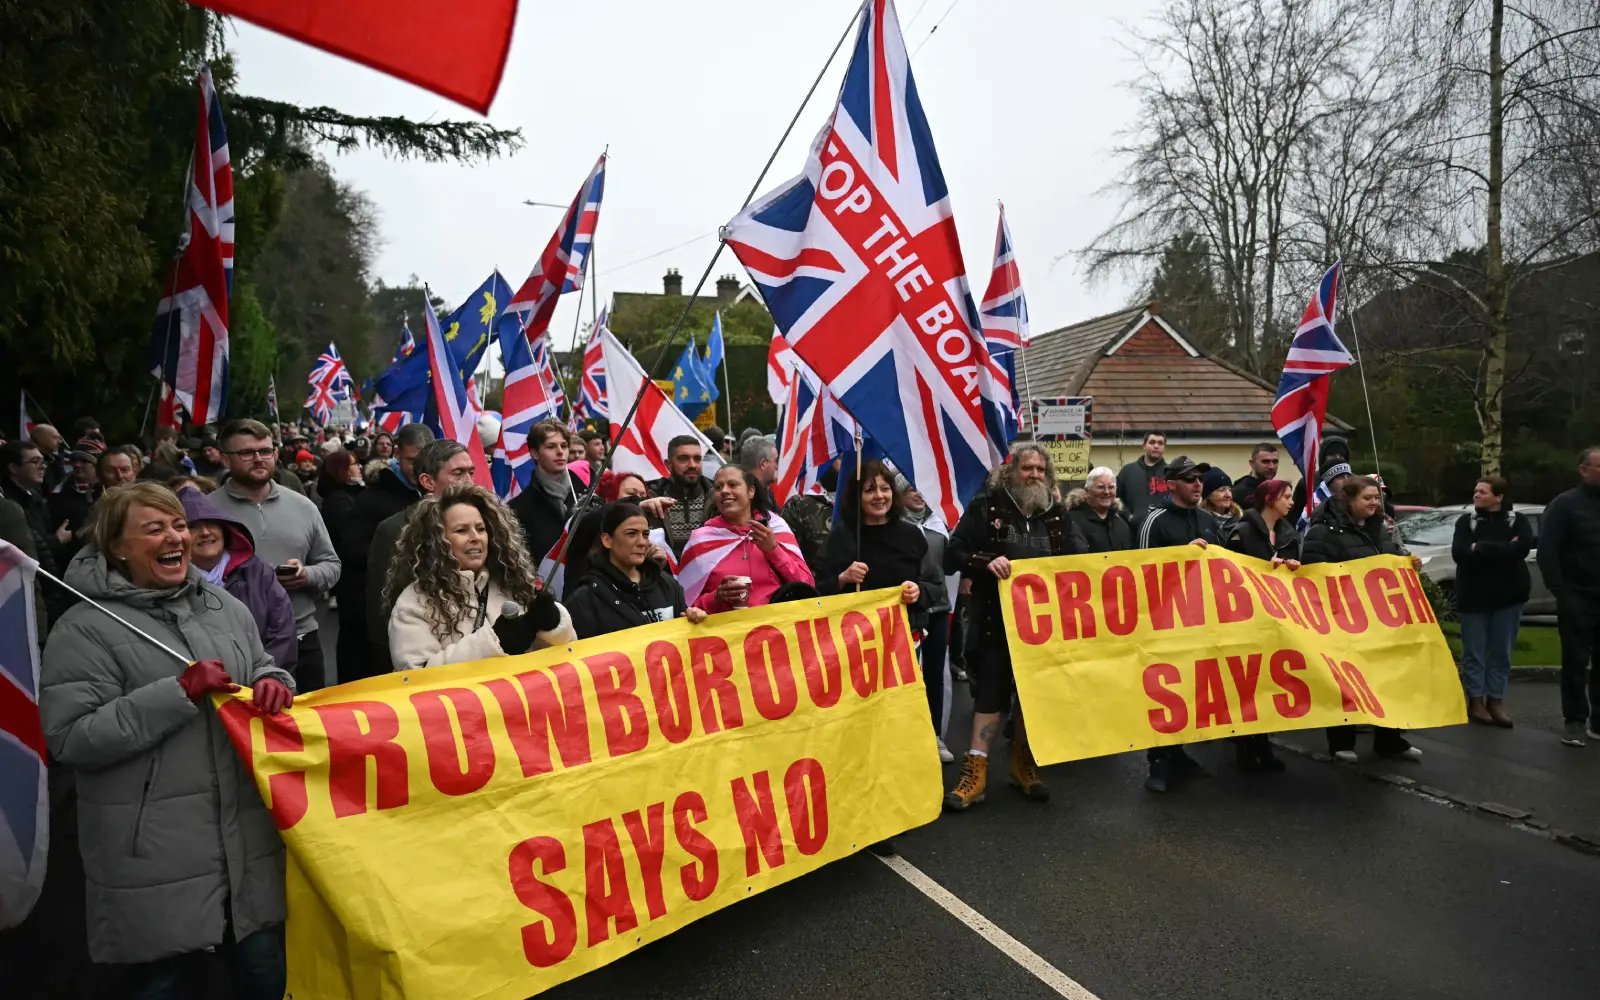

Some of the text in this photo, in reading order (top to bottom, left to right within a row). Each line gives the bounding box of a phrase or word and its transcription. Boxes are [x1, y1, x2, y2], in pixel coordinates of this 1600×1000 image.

[819, 140, 872, 216] OP
[862, 213, 934, 302] THE
[1055, 465, 1087, 475] BOROUGH
[1069, 452, 1083, 463] OF
[1012, 558, 1435, 646] CROWBOROUGH
[217, 604, 917, 831] CROWBOROUGH
[1142, 649, 1385, 734] SAYS NO
[508, 757, 829, 968] SAYS NO
